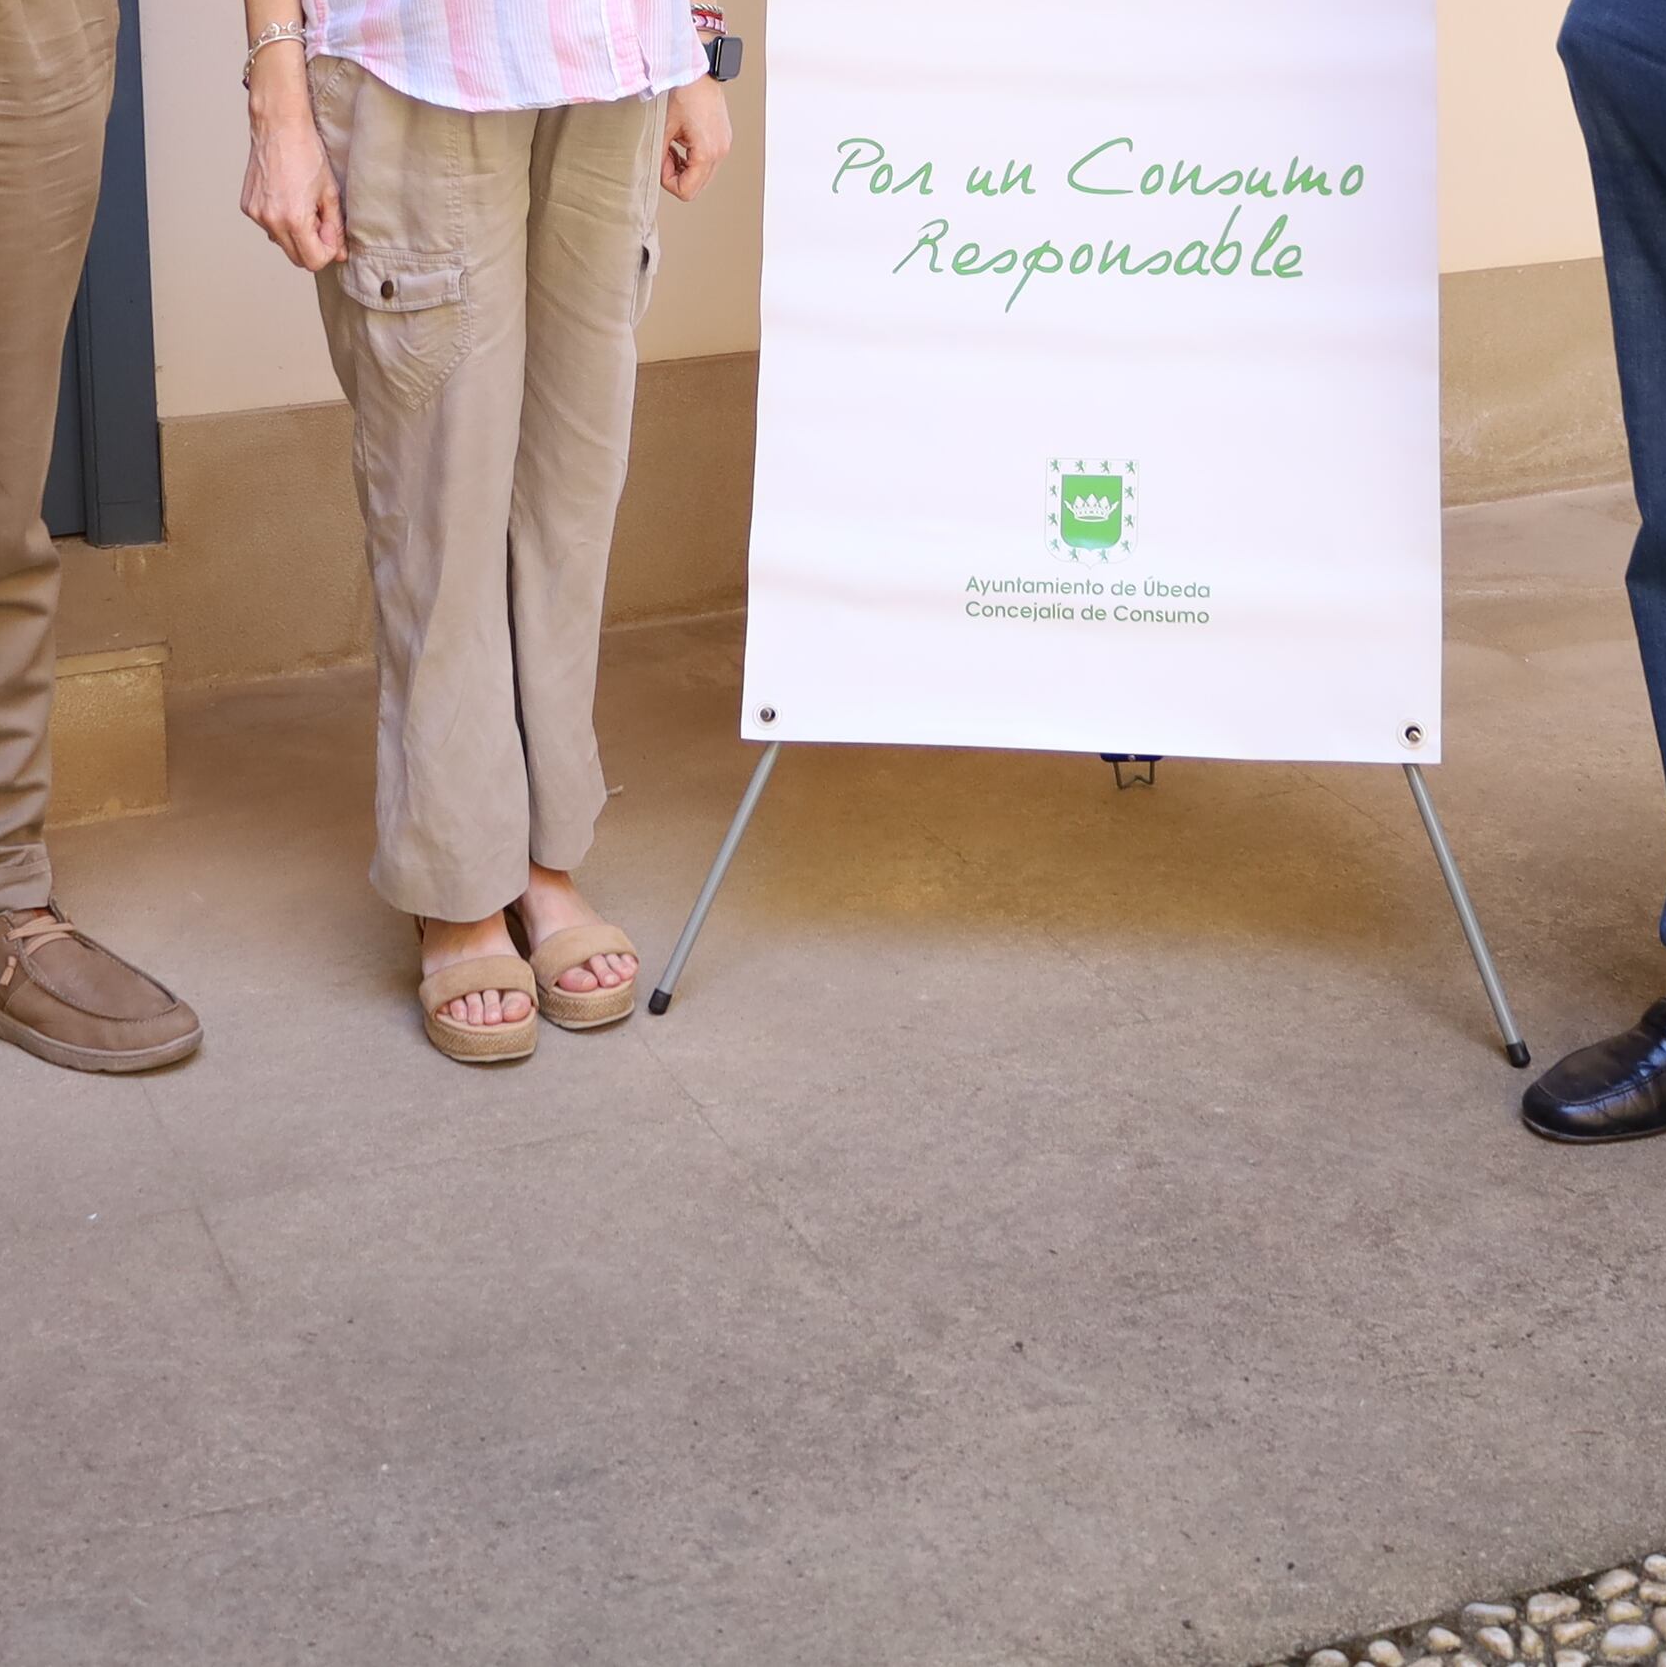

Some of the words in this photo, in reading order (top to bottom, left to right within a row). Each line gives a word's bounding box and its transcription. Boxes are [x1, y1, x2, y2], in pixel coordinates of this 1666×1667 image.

[831, 137, 934, 196] Por
[965, 159, 1037, 197] un
[1067, 136, 1365, 199] Consumo
[892, 204, 1304, 314] Responsable
[965, 575, 1105, 597] Ayuntamiento
[1110, 580, 1137, 597] de
[1143, 576, 1211, 599] Úbeda
[965, 600, 1075, 623] Concejalía
[1080, 604, 1108, 621] de
[1113, 605, 1210, 624] Consumo
